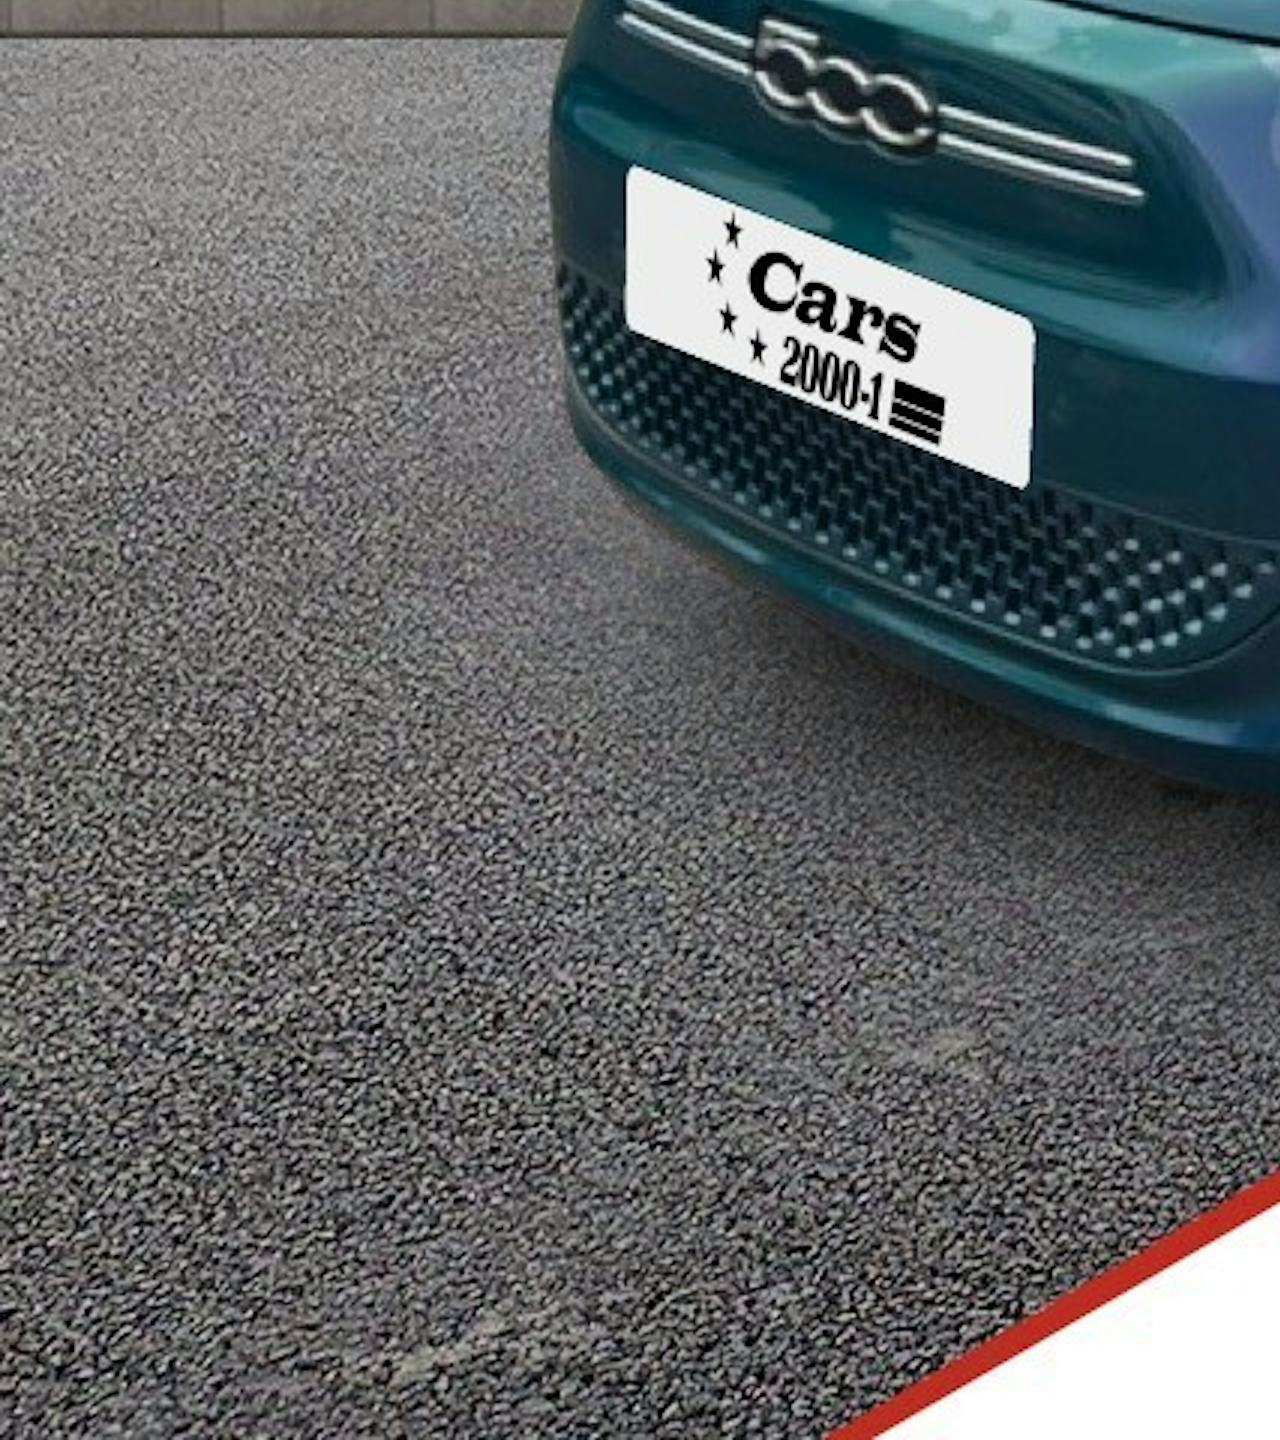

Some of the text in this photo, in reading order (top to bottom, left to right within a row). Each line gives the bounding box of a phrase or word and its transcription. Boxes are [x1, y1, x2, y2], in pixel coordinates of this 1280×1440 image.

[754, 18, 936, 152] 500
[748, 252, 921, 363] Cars
[780, 336, 884, 421] 2000-1
